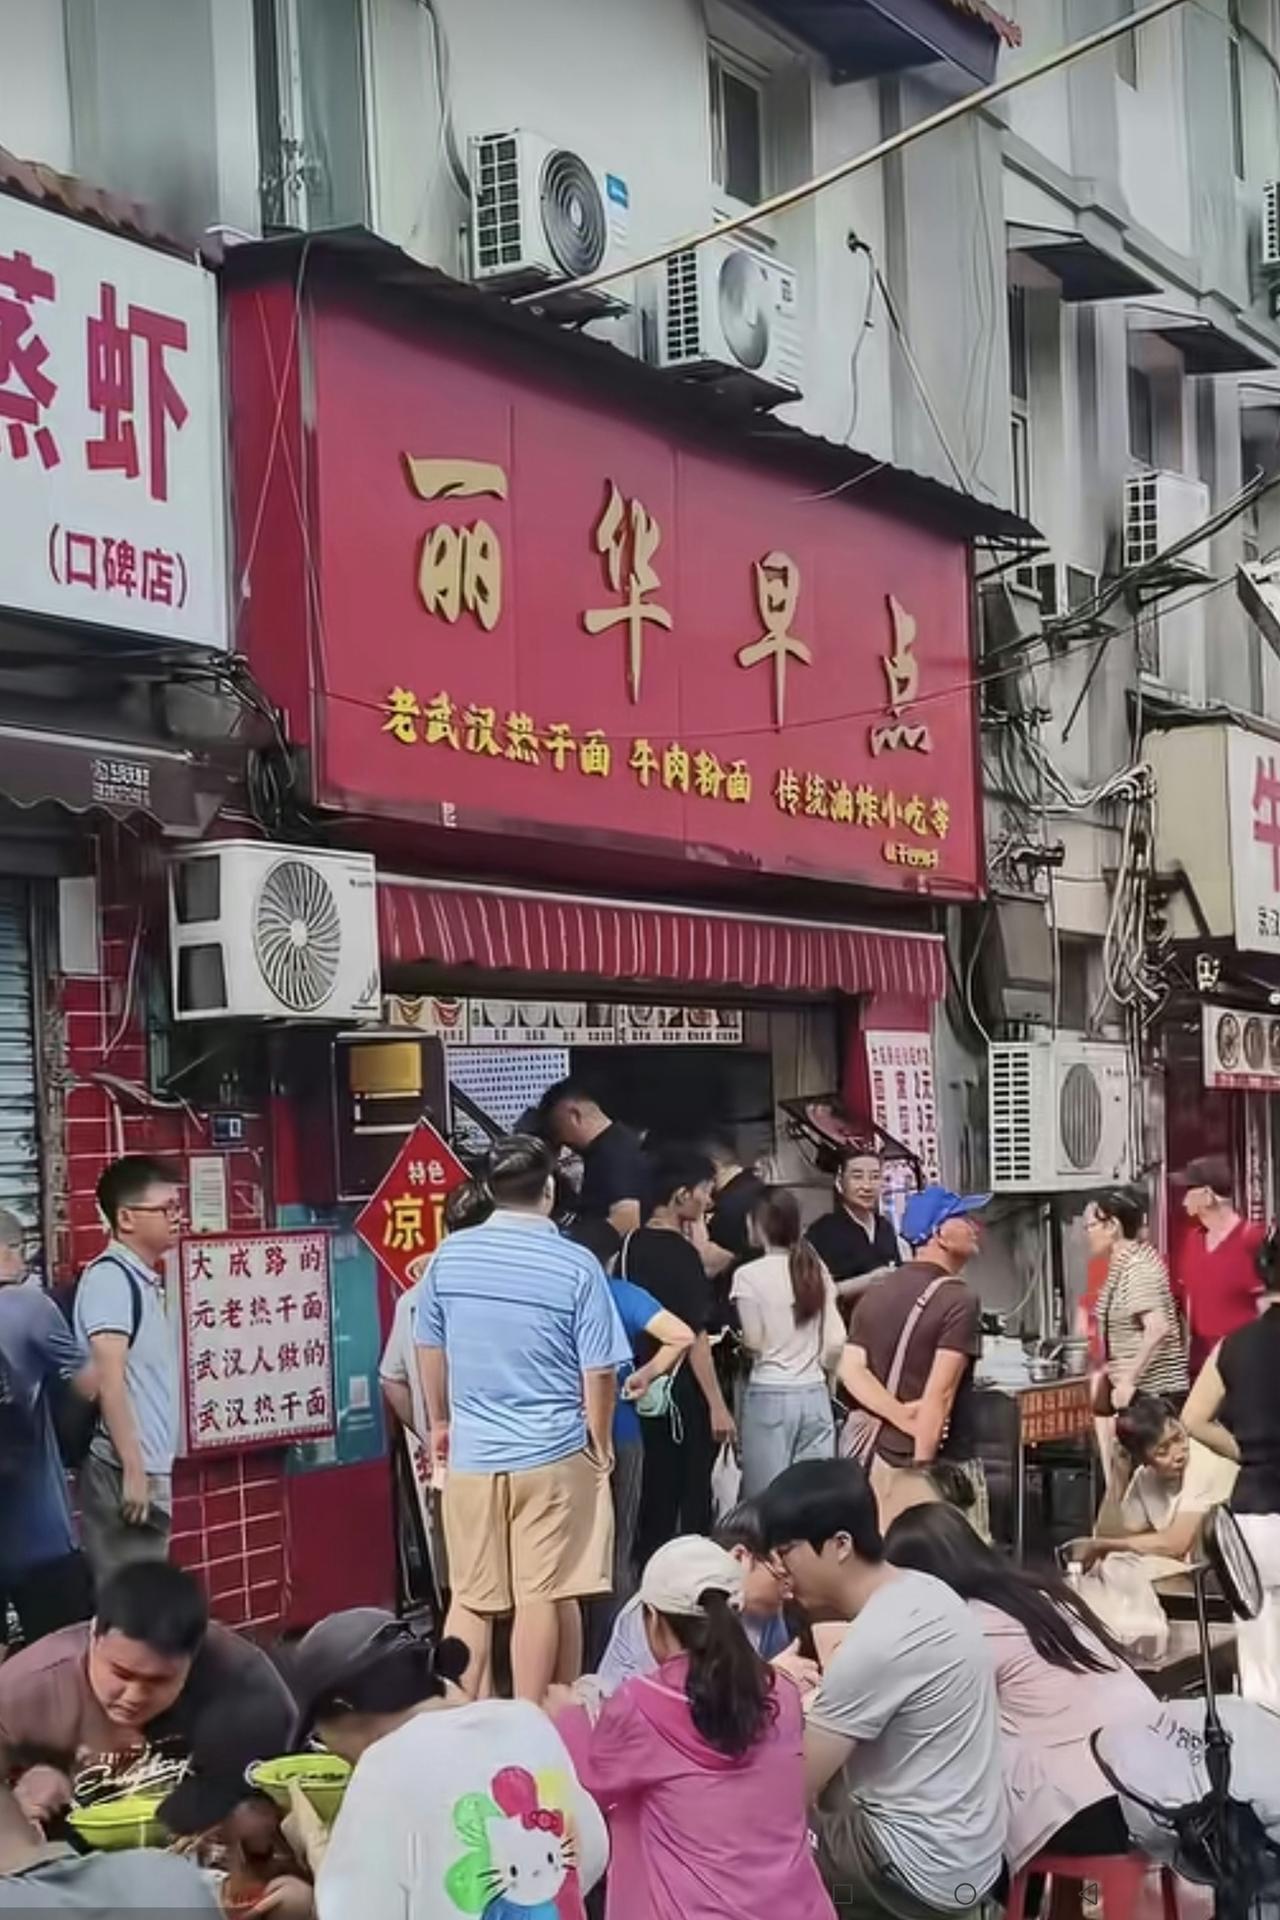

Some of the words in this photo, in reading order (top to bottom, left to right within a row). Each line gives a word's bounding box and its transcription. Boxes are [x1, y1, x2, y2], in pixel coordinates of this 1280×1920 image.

[400, 451, 934, 758] 丽华早点
[382, 686, 611, 778] 老武汉热干面
[630, 738, 751, 803] 牛肉粉面
[775, 767, 950, 840] 传统油炸小吃等
[408, 1159, 447, 1187] 特色
[191, 1243, 321, 1281] 大成路的
[191, 1291, 323, 1329] 元老热干面
[193, 1339, 326, 1381] 武汉人做的
[199, 1386, 327, 1433] 武汉热干面
